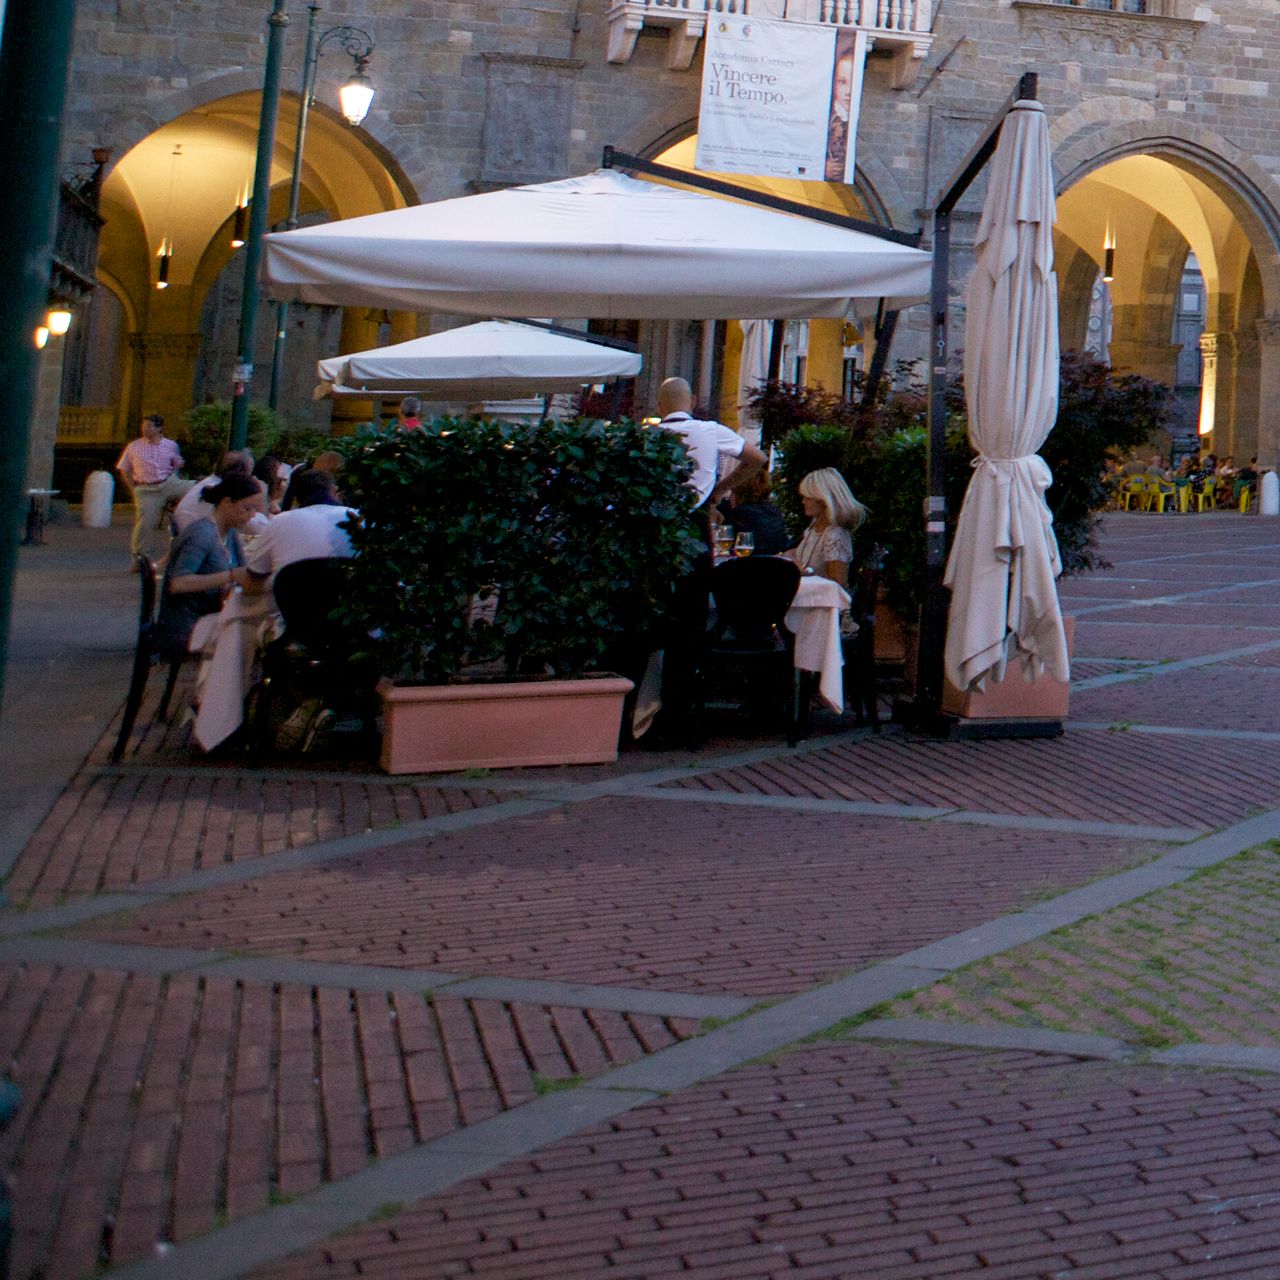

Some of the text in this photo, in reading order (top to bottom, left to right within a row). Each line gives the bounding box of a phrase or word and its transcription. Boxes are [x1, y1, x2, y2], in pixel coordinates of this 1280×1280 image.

[711, 62, 777, 86] Vincere
[708, 80, 788, 105] il Tempo.
